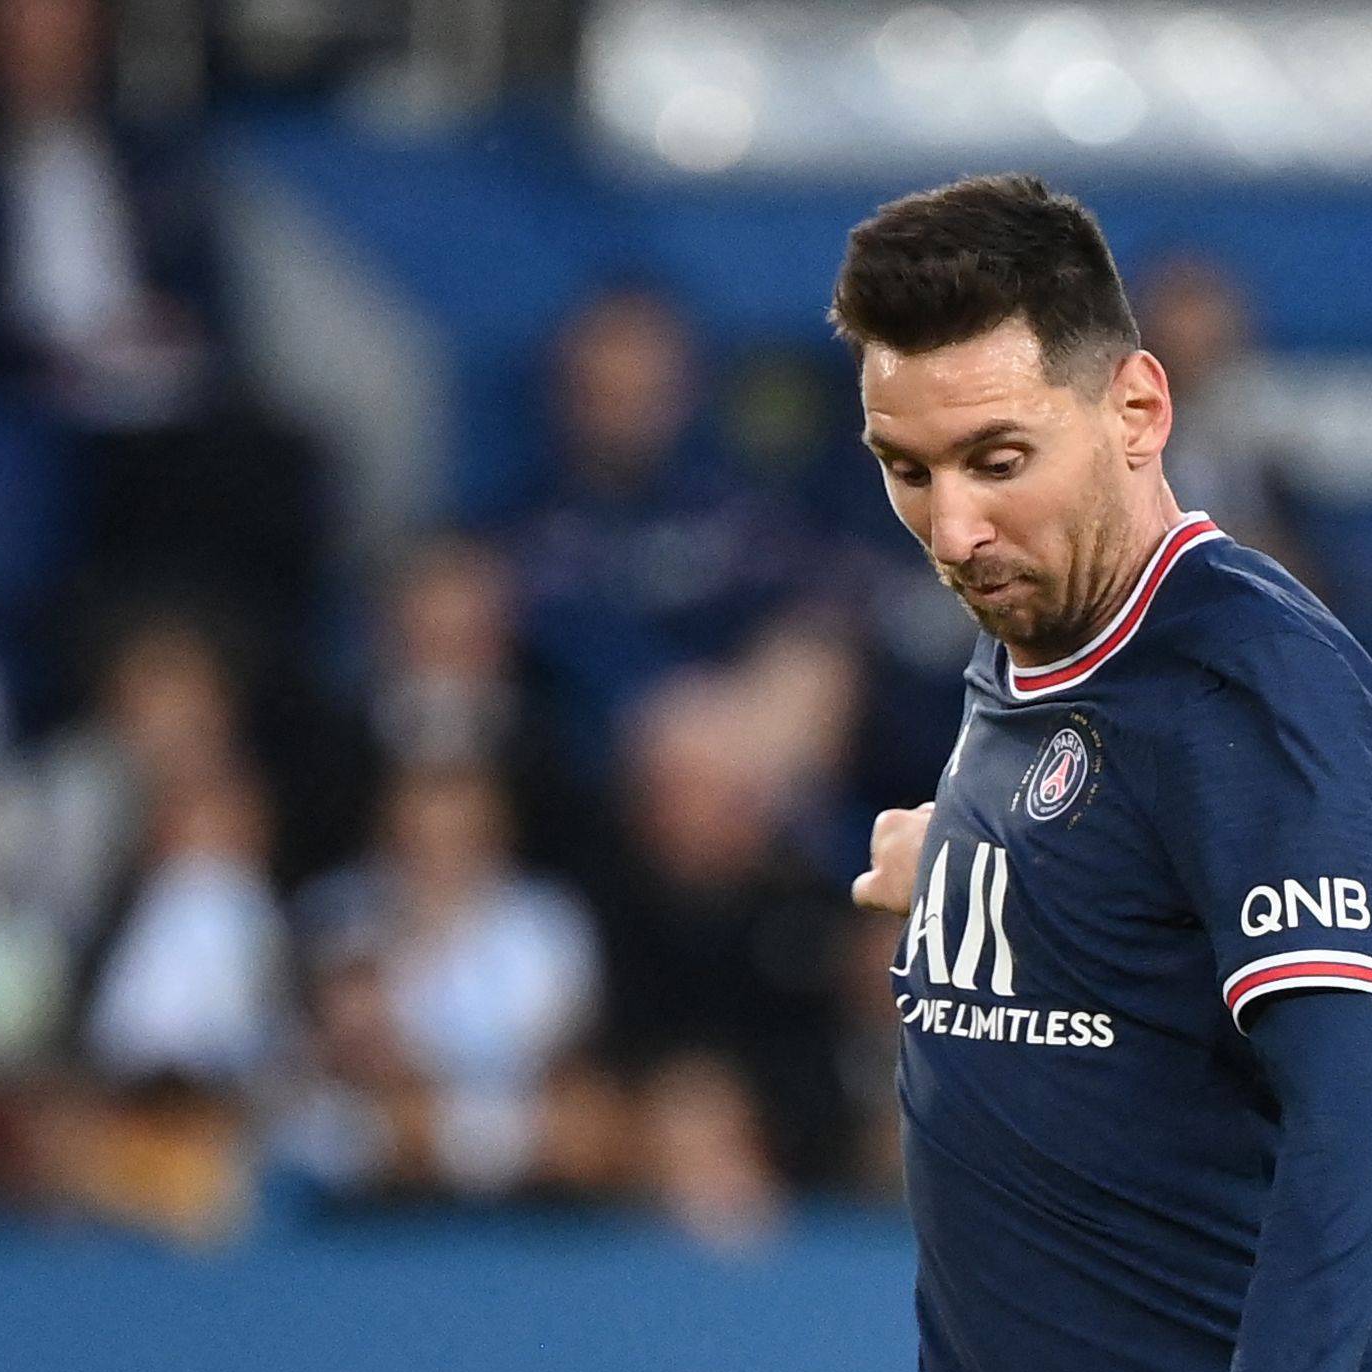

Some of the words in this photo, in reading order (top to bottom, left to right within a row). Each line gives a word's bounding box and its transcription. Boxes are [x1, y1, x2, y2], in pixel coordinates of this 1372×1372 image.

[1053, 734, 1083, 762] PARIS
[1240, 876, 1372, 937] QNB
[950, 1003, 1115, 1048] LIMITLESS
